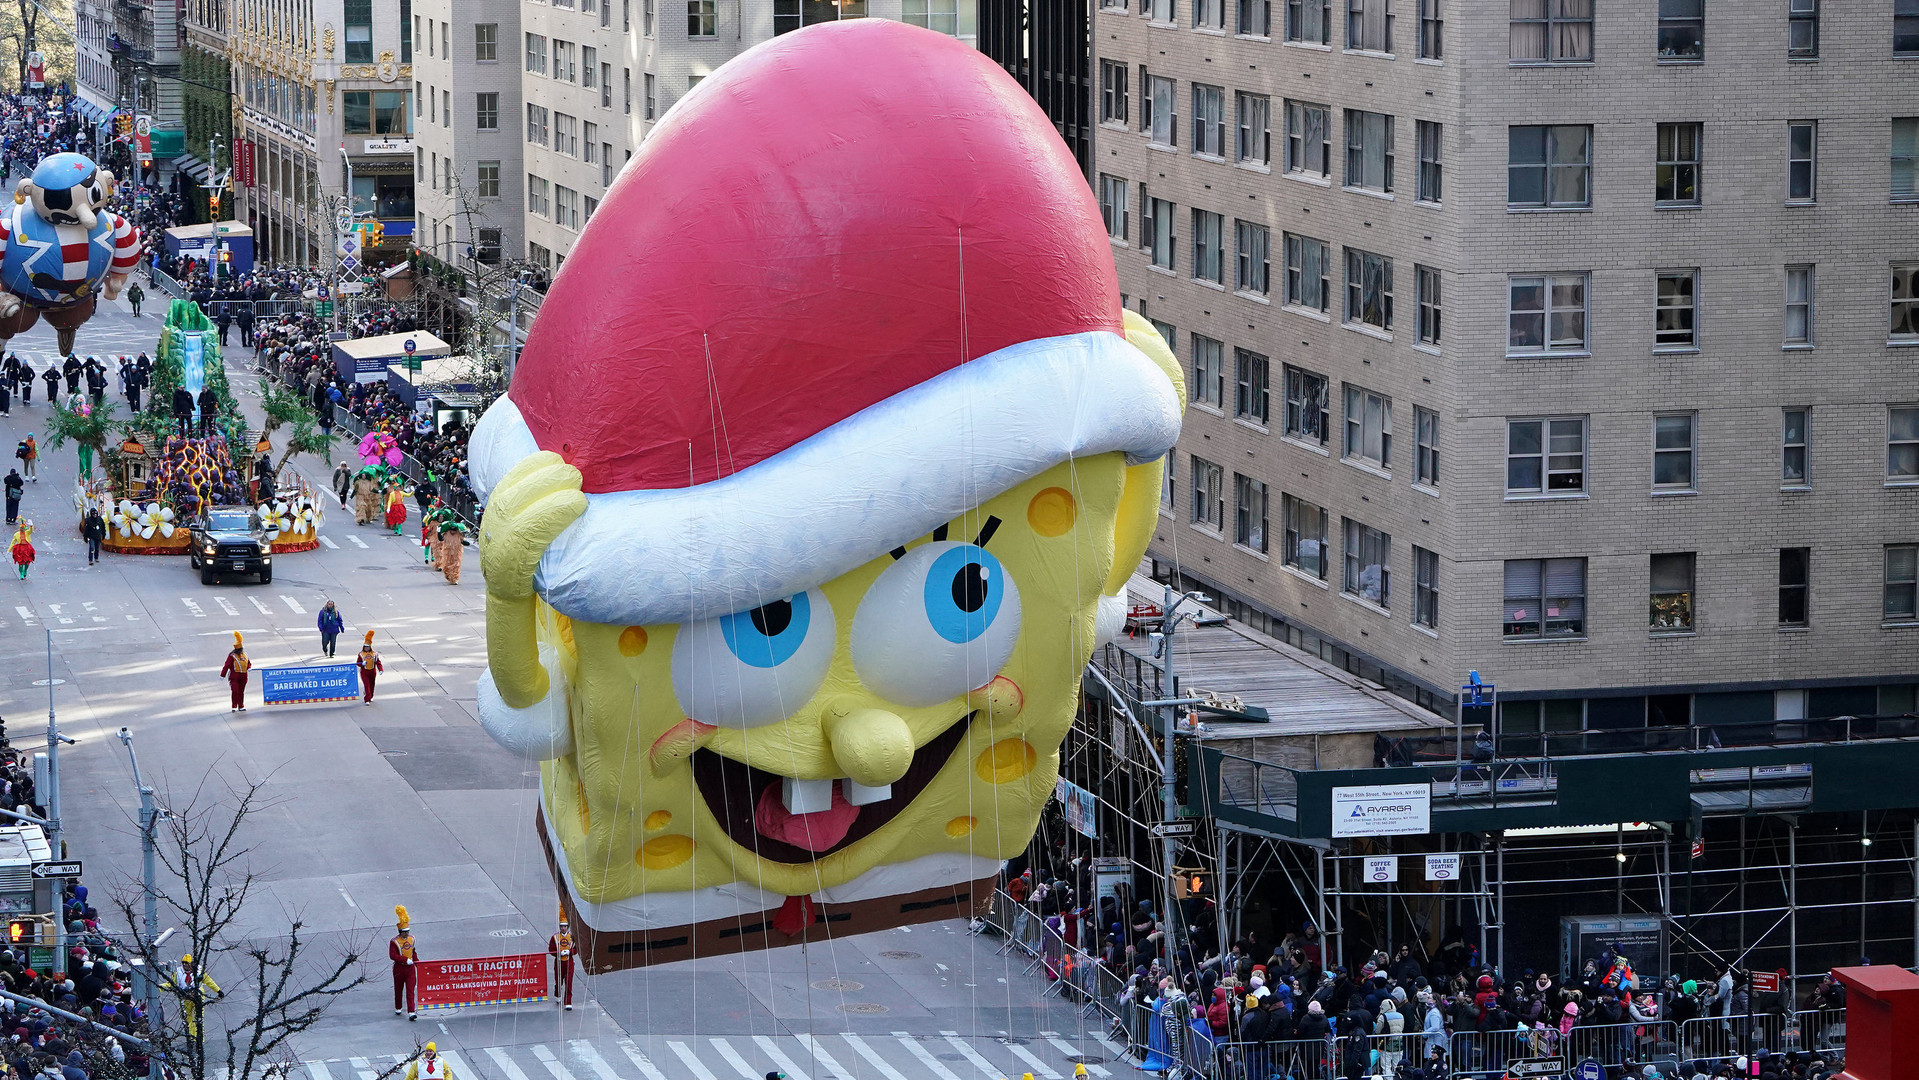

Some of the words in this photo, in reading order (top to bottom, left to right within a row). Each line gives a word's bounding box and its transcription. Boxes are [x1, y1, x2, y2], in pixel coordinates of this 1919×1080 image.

[274, 680, 318, 690] BARENAKED
[321, 679, 348, 687] LADIES
[1367, 805, 1412, 813] AVARGA
[440, 963, 473, 974] STORR
[478, 960, 523, 971] TRACTOR
[426, 983, 450, 991] MACY'S
[452, 979, 498, 989] THANKSGIVING
[1515, 1064, 1532, 1072] ONE
[1541, 1062, 1560, 1070] WAY
